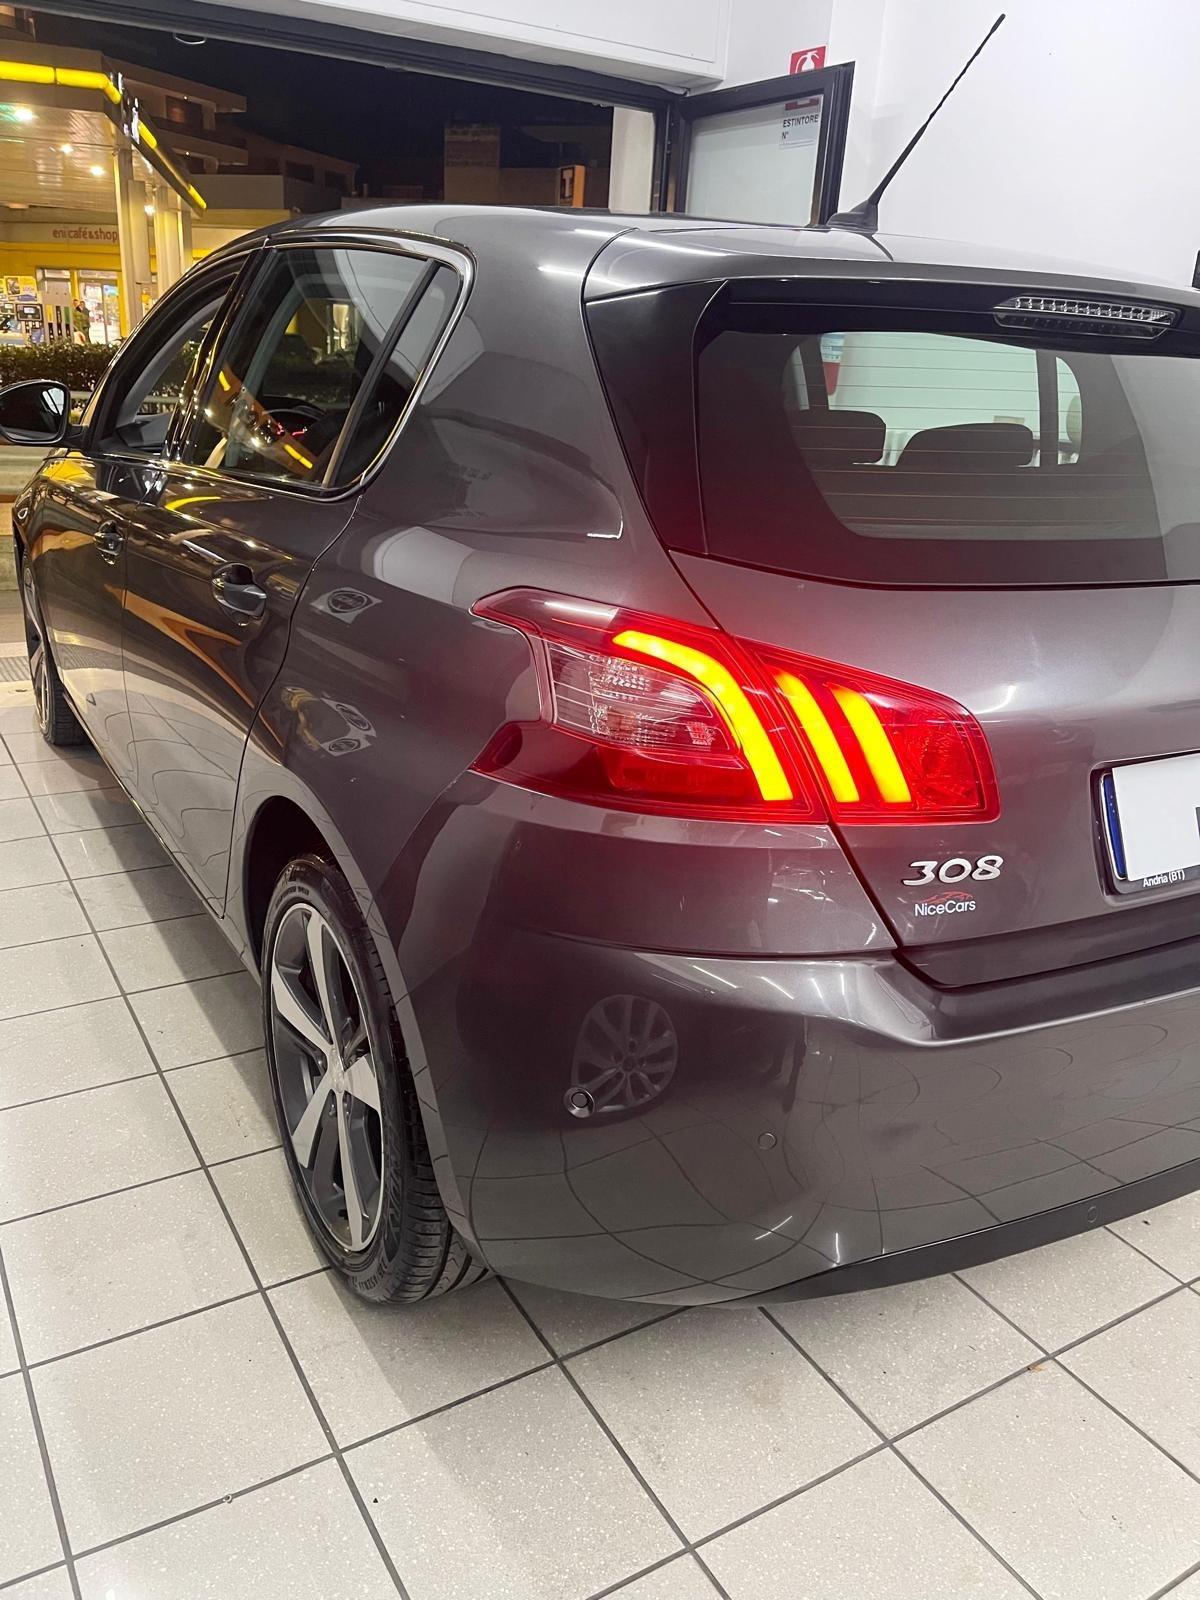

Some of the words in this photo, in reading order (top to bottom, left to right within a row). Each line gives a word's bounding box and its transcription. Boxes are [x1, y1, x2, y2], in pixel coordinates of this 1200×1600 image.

[783, 114, 819, 128] ESTINTORE
[902, 855, 1004, 886] 308
[1143, 873, 1168, 887] Andria
[1168, 869, 1186, 883] (BT)
[914, 900, 976, 917] NiceCars
